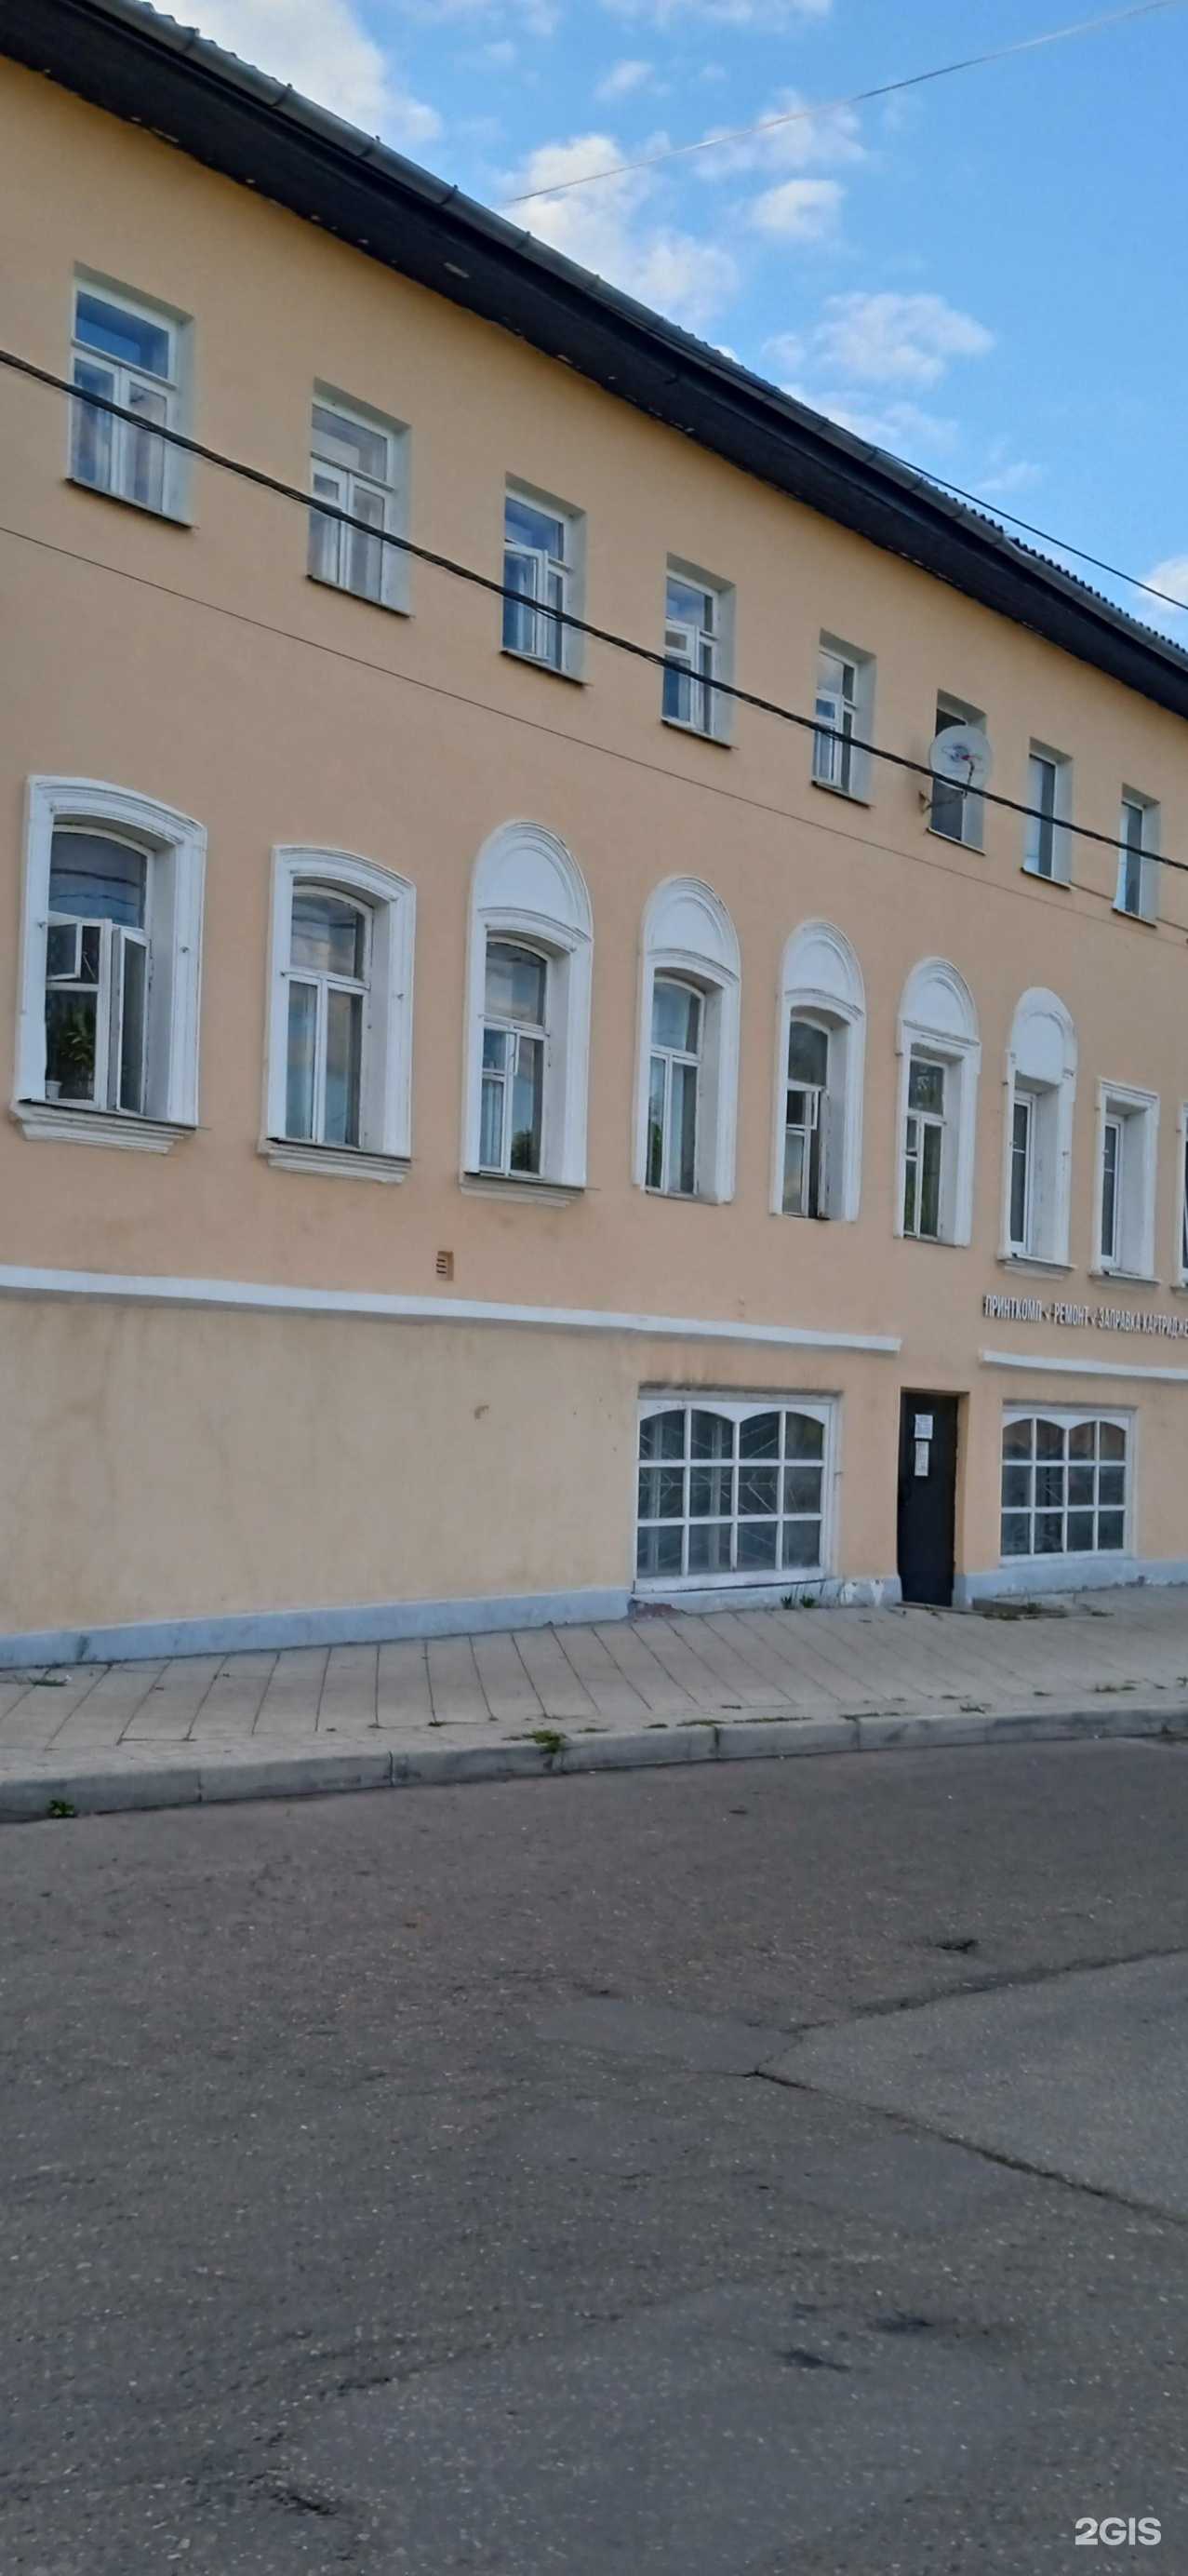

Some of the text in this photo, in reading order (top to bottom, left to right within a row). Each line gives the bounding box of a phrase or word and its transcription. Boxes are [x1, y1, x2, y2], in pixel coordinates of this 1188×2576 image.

[984, 1295, 1043, 1322] ПРИНТКОМП
[1053, 1302, 1089, 1326] РЕМОНТ
[1099, 1307, 1141, 1333] ЗАПРАВКА
